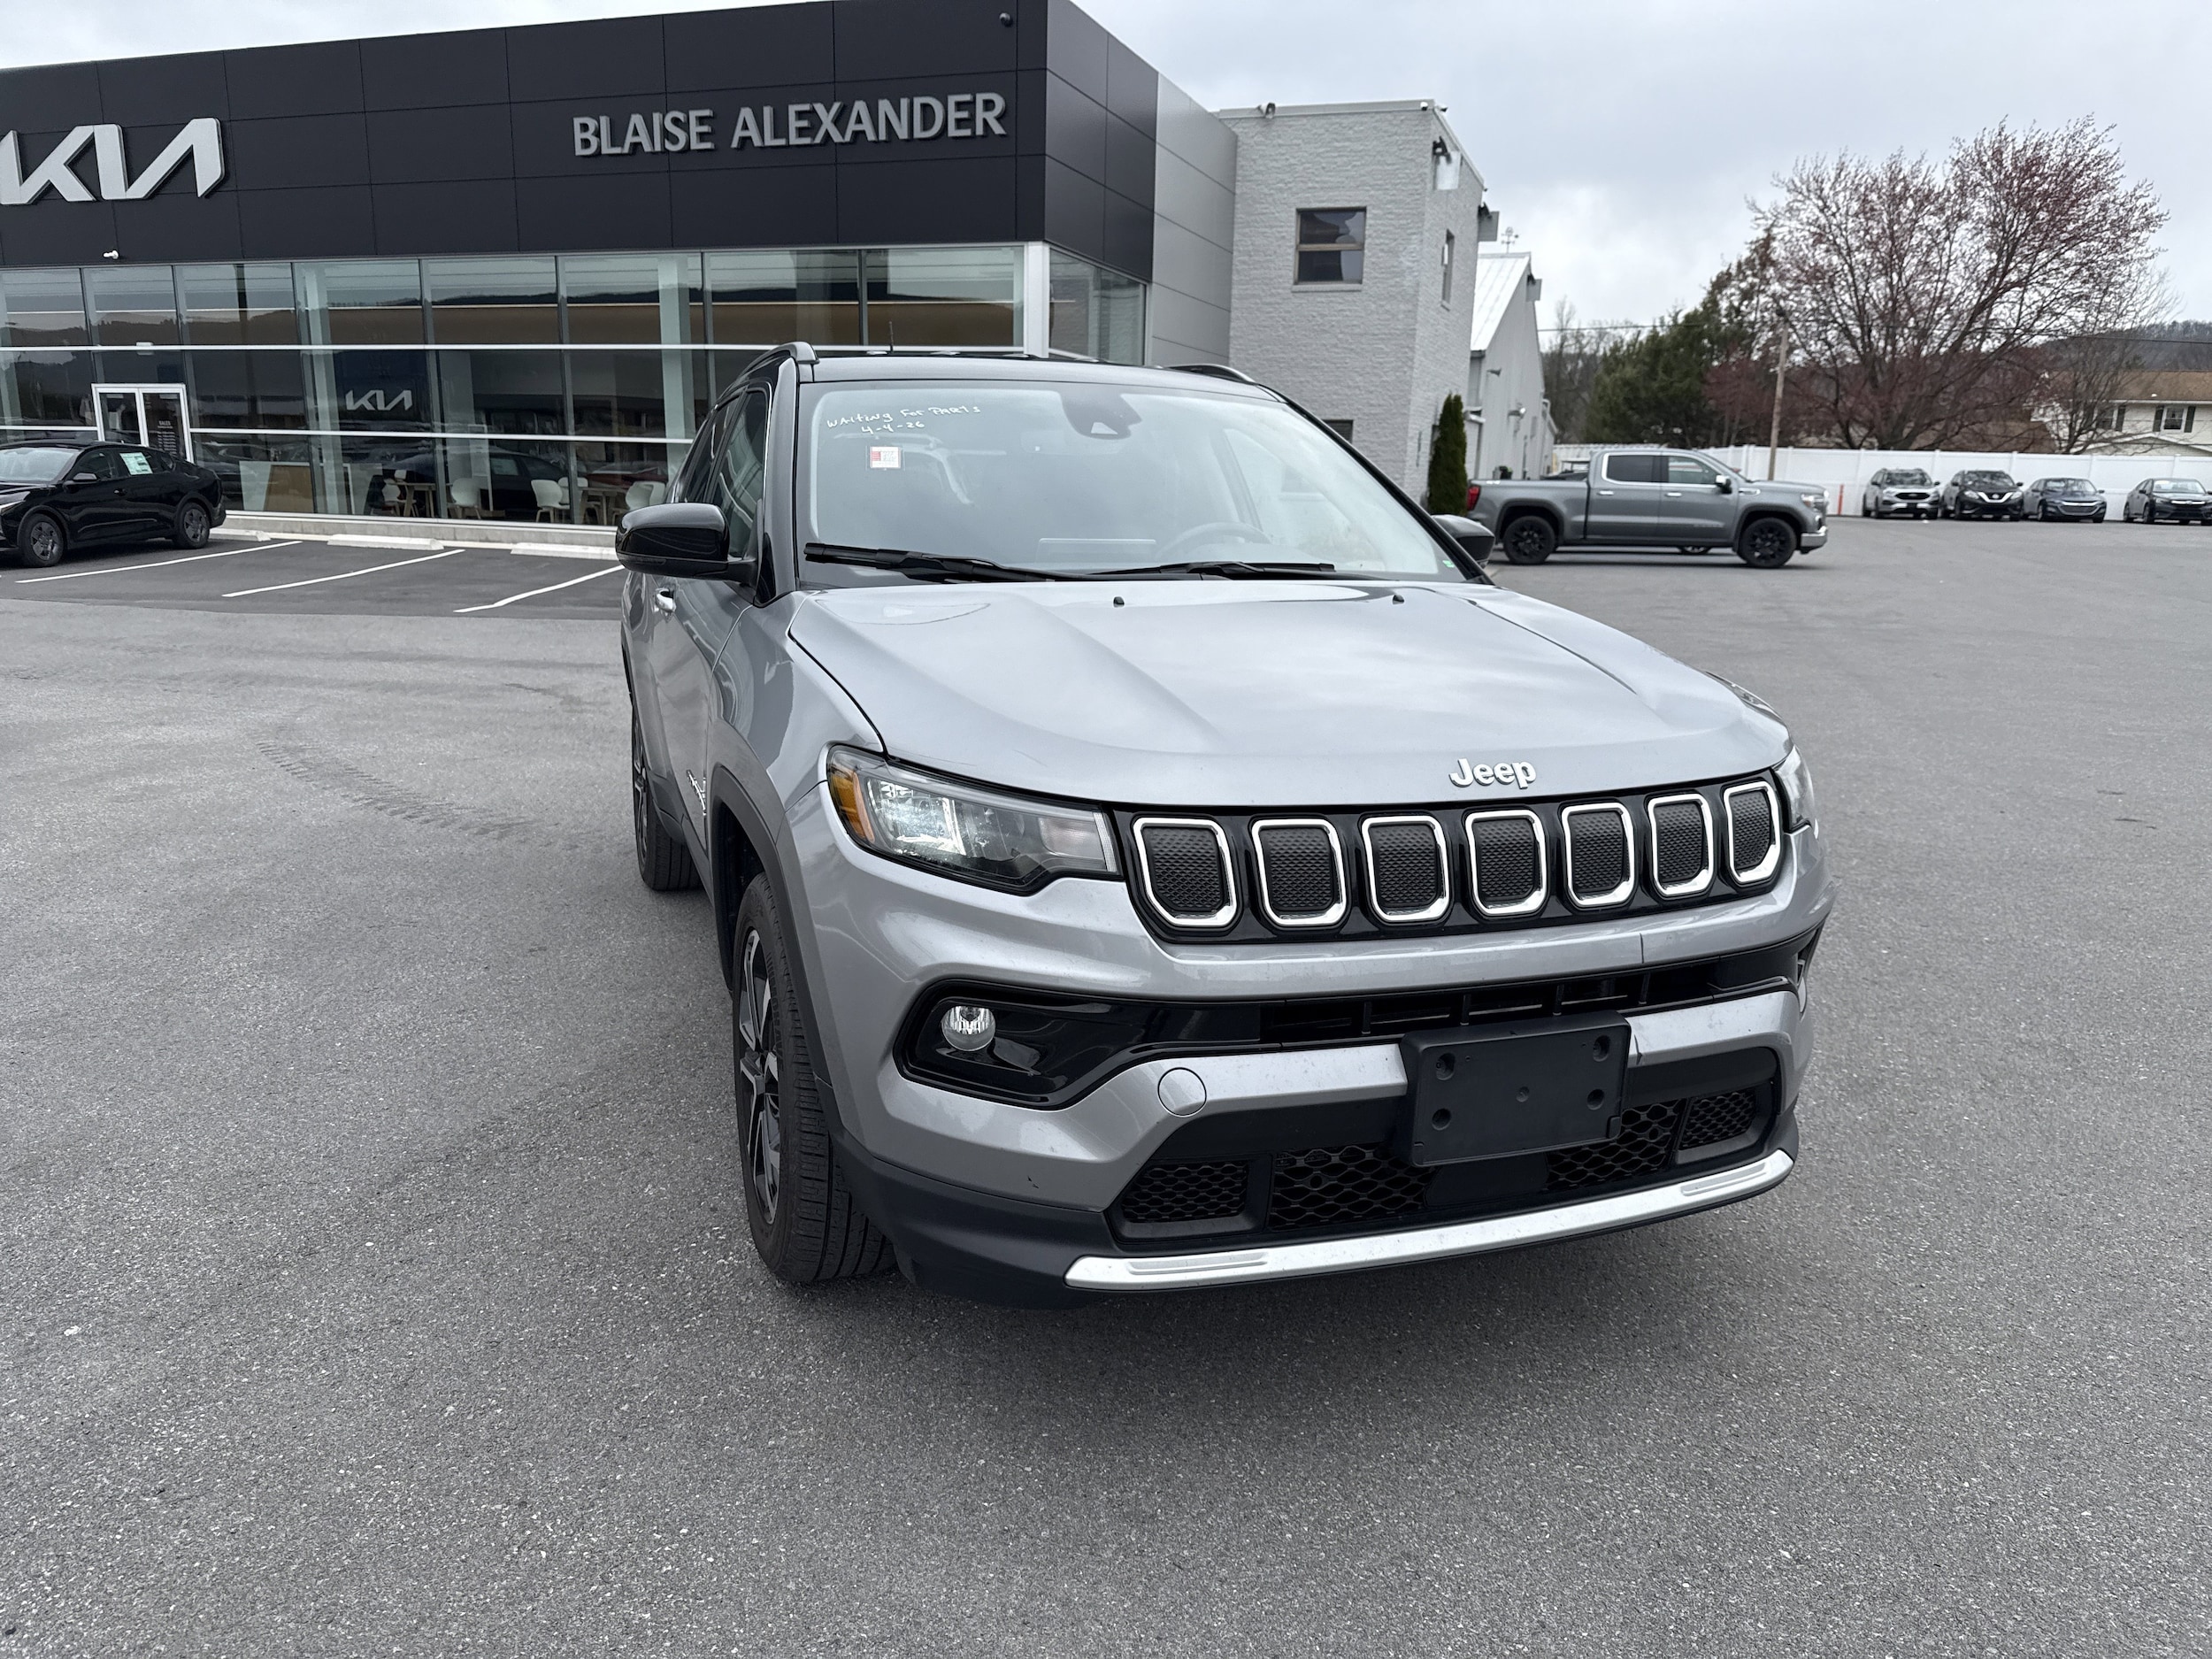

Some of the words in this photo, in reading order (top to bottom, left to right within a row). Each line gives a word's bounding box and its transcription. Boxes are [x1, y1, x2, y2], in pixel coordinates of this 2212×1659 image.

[573, 109, 714, 156] BLAISE
[731, 92, 1006, 149] ALEXANDER
[0, 118, 225, 204] KIA
[345, 389, 412, 411] KIA
[861, 420, 926, 434] 4-4-26
[1448, 758, 1537, 789] Jeep
